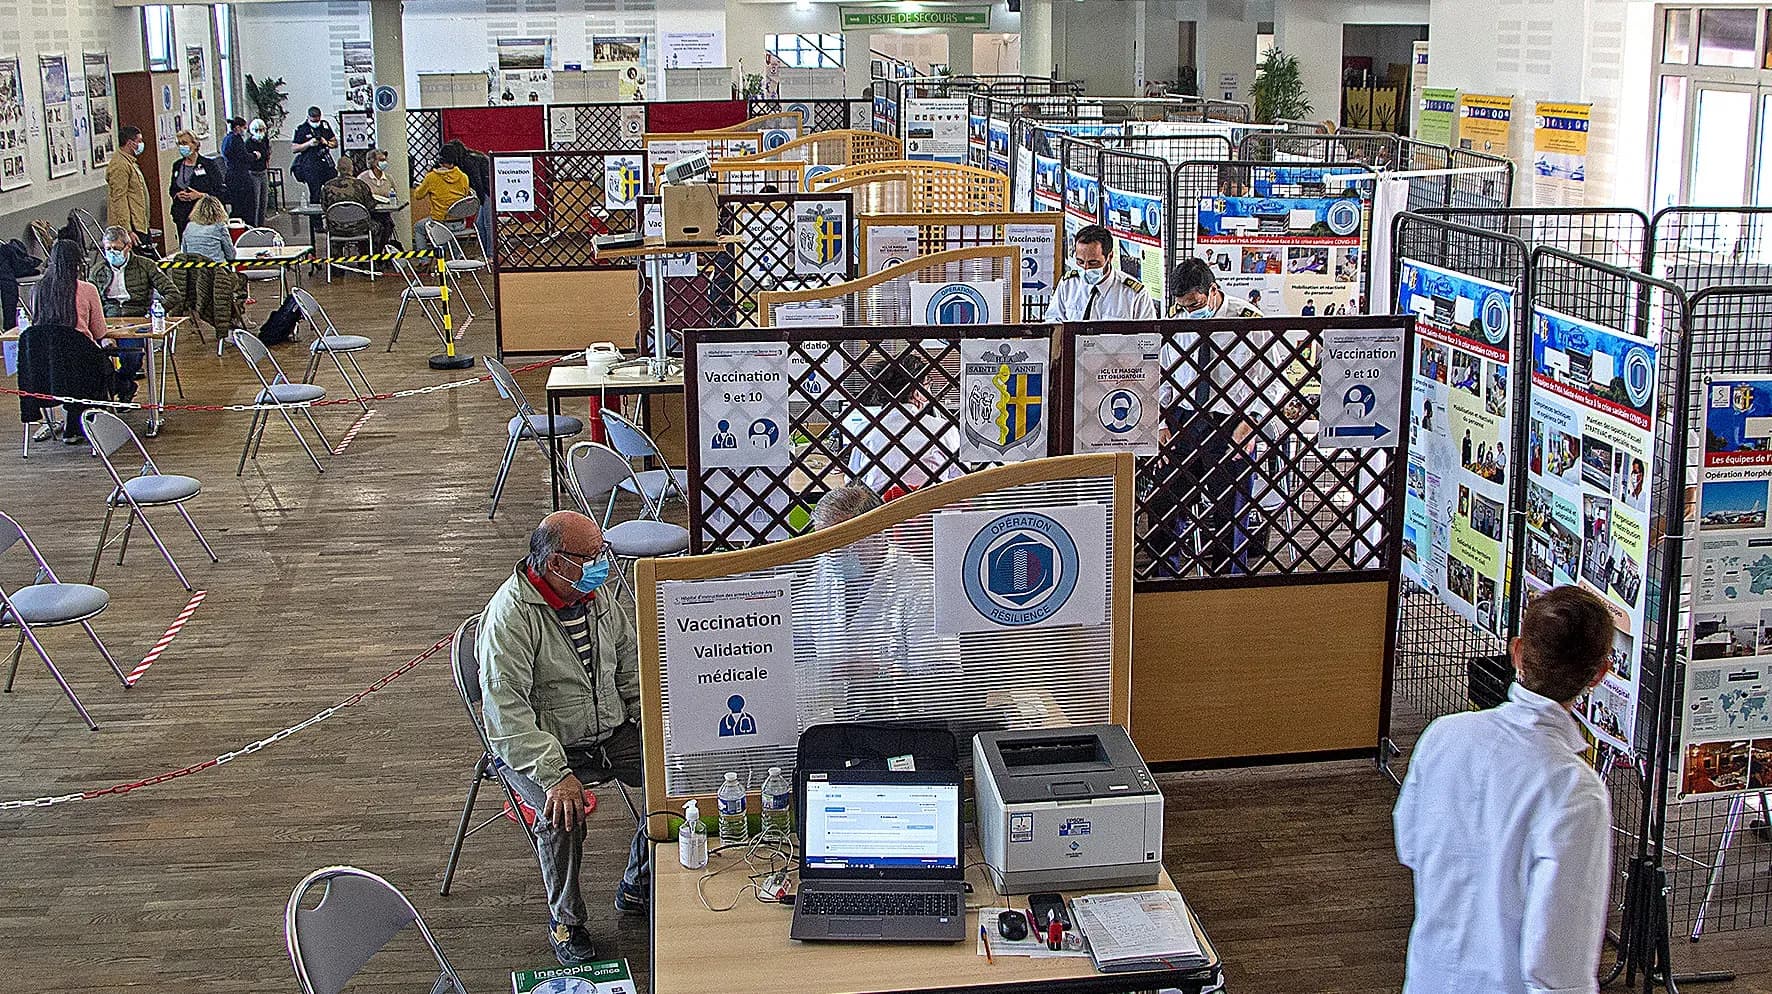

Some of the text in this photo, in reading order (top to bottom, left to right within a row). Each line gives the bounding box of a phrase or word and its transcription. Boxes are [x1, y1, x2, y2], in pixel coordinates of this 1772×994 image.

[868, 13, 958, 24] ISSUE DE SECOURS
[1008, 235, 1051, 243] Vaccination
[1329, 348, 1397, 360] Vaccination
[705, 371, 780, 384] Vaccination
[1344, 369, 1379, 379] 9 et 10
[724, 392, 763, 403] 9 et 10
[1712, 456, 1725, 464] Les
[1725, 455, 1754, 465] équipes
[1755, 454, 1766, 463] de
[1705, 471, 1742, 480] Opération
[991, 517, 1052, 535] OPÉRATION
[990, 606, 1050, 623] RÉSILIENCE
[677, 612, 781, 632] Vaccination
[694, 642, 773, 658] Validation
[698, 667, 768, 684] médicale
